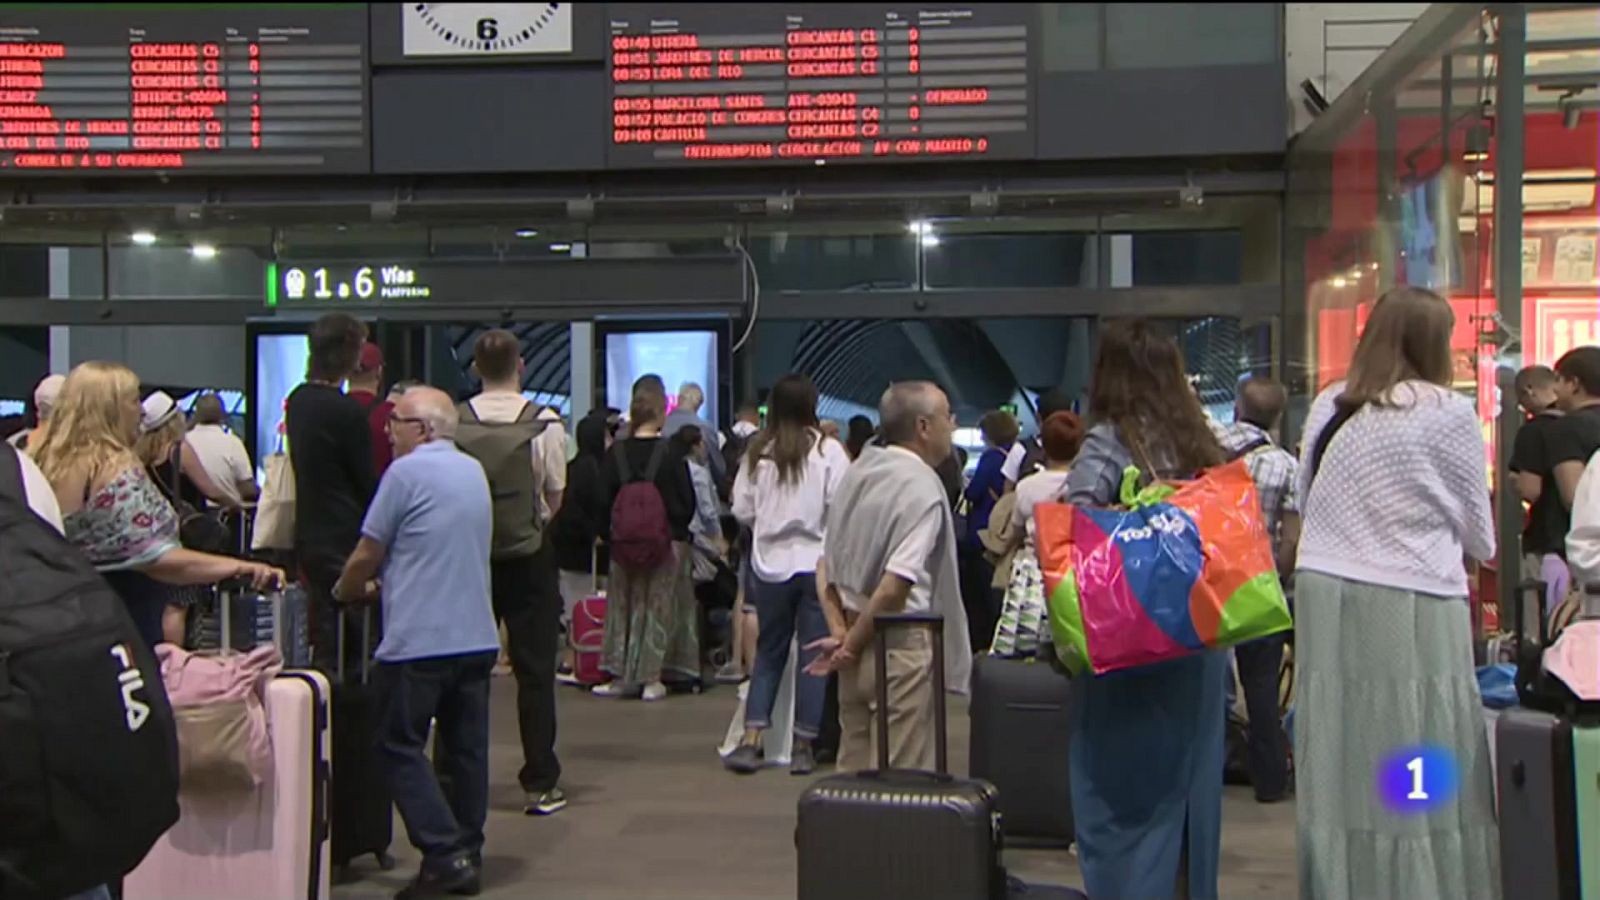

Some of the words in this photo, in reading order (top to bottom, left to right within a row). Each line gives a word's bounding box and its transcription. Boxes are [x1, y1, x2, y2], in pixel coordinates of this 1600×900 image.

[476, 18, 499, 40] 6
[651, 34, 698, 48] UTRERA
[787, 30, 855, 44] CERCANIAS
[860, 29, 877, 42] C1
[130, 43, 198, 57] CERCANIAS
[655, 50, 713, 64] JARDINES
[718, 49, 735, 62] DE
[787, 46, 856, 60] CERCANIAS
[861, 45, 879, 58] C5
[131, 59, 199, 73] CERCANIAS
[688, 65, 712, 79] DEL
[718, 64, 743, 79] RIO
[787, 62, 856, 76] CERCANIAS
[860, 61, 877, 75] C1
[131, 75, 199, 88] CERCANIAS
[653, 96, 721, 110] BARCELONA
[653, 112, 706, 126] PALACIO
[711, 111, 727, 124] DE
[788, 108, 856, 122] CERCANIAS
[132, 120, 200, 134] CERCANIAS
[653, 127, 706, 141] CARTUJA
[788, 123, 856, 138] CERCANIAS
[861, 123, 880, 137] C2
[64, 136, 90, 149] RIO
[132, 135, 201, 149] CERCANIAS
[778, 142, 863, 157] CIRCULACION
[873, 141, 890, 154] AV
[896, 140, 921, 153] CON
[925, 138, 972, 153] MADRID
[80, 152, 91, 167] A
[313, 267, 332, 298] 1
[354, 266, 375, 298] 6
[381, 265, 416, 284] Vías
[110, 643, 151, 732] FILA
